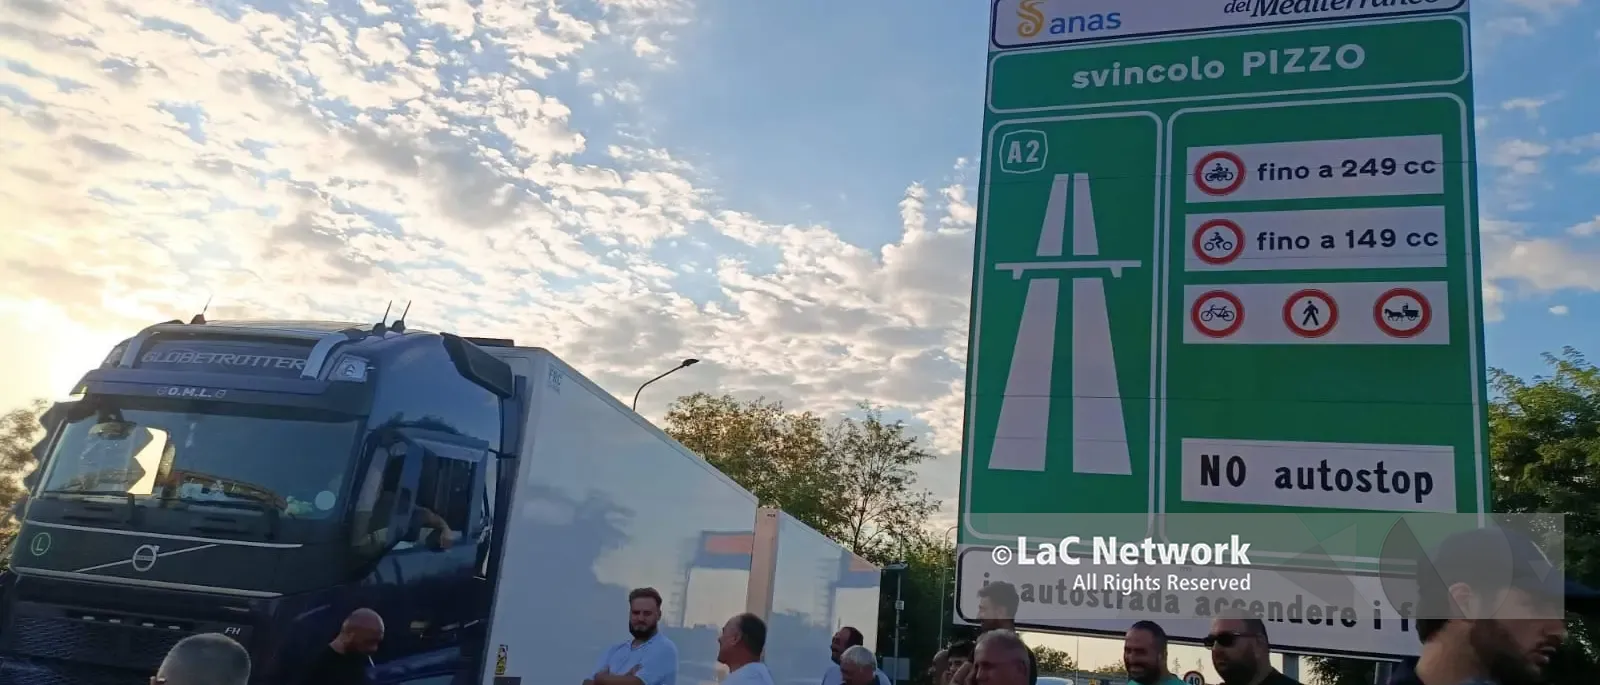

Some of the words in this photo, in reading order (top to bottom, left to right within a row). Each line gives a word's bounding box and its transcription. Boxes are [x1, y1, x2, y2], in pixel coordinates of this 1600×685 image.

[1250, 0, 1439, 17] Mediterra
[1049, 12, 1122, 34] anas
[1072, 56, 1225, 89] svincolo
[1243, 43, 1366, 77] PIZZO
[1007, 140, 1040, 163] A2
[1257, 163, 1310, 181] fino
[1318, 166, 1333, 178] a
[1341, 157, 1397, 178] 249
[1404, 160, 1436, 175] cc
[1257, 231, 1310, 250] fino
[1320, 235, 1335, 249] a
[1345, 229, 1396, 249] 149
[1406, 232, 1439, 247] cc
[141, 350, 307, 370] GLOBETROTTER
[1200, 454, 1246, 487] NO
[1274, 459, 1433, 503] autostop
[1020, 578, 1180, 614] autostrada
